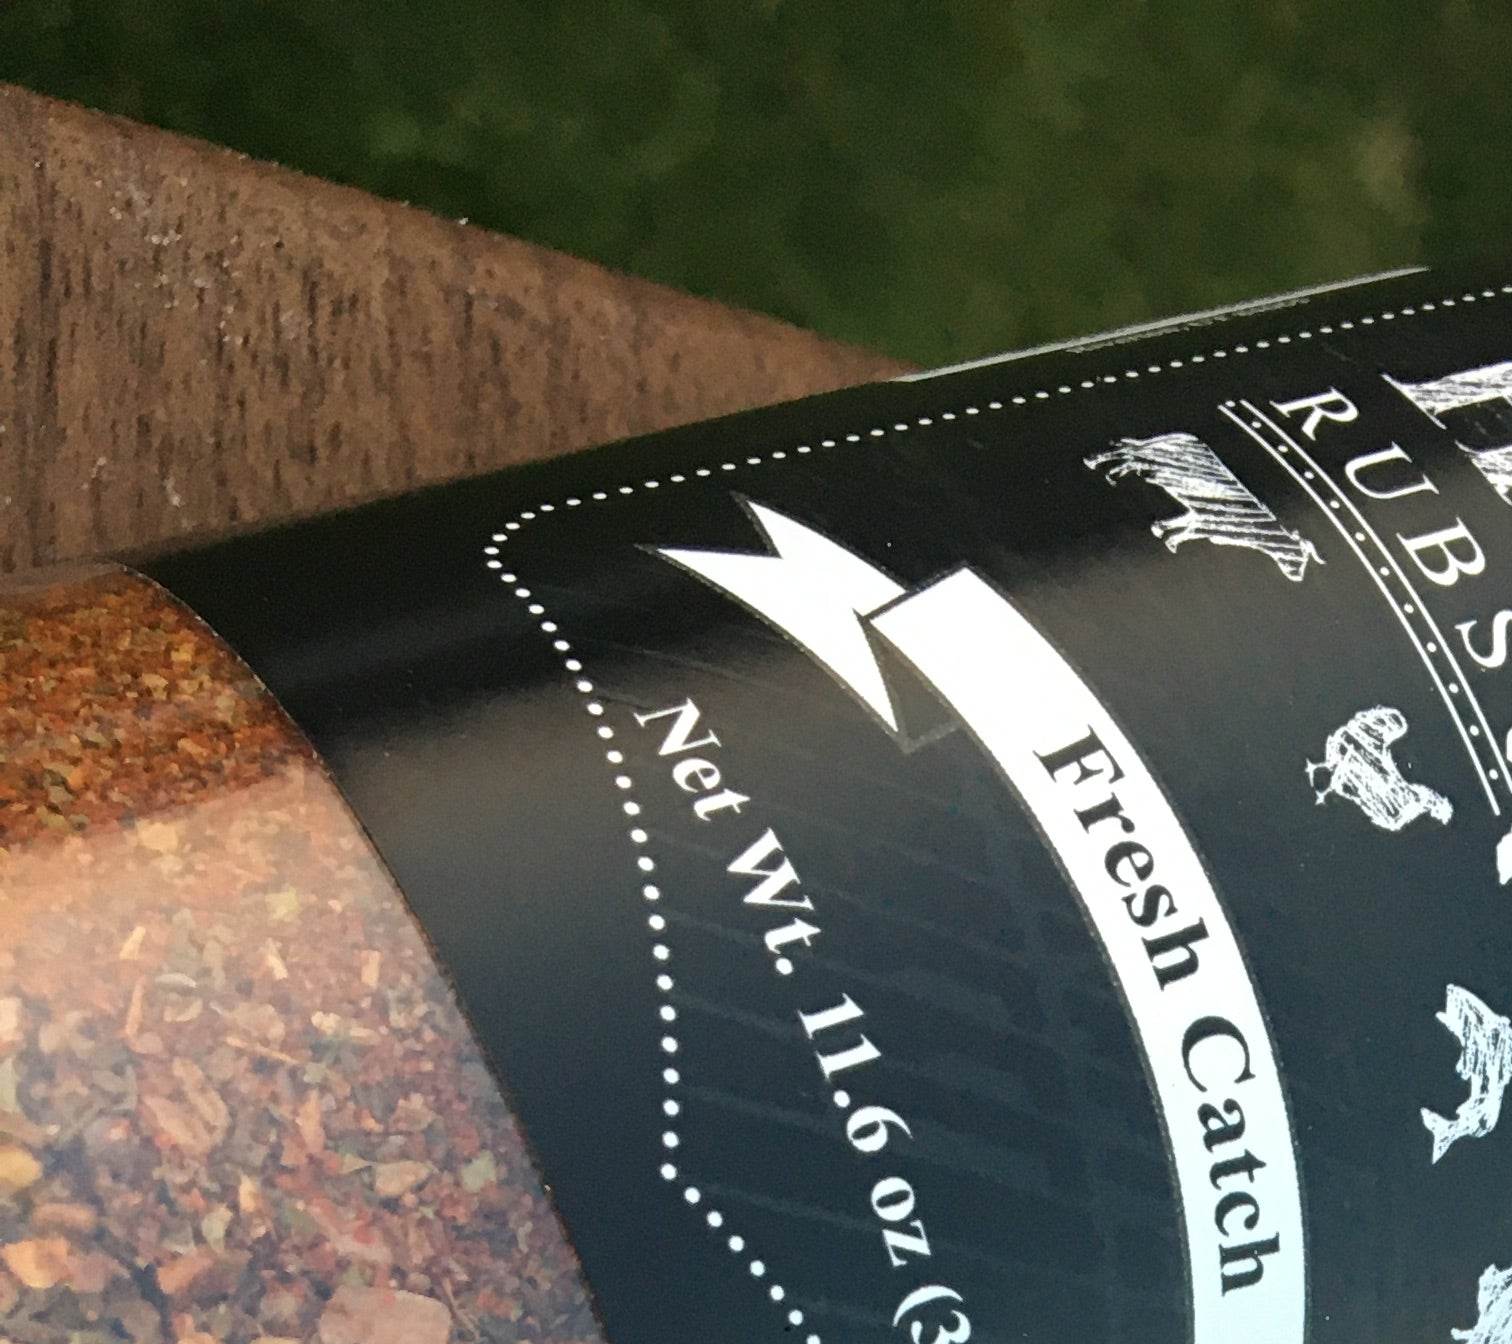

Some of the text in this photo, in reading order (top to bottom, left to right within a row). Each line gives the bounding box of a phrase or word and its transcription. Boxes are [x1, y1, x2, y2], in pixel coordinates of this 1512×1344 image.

[632, 696, 752, 823] Net
[726, 826, 822, 976] Wt.
[797, 992, 914, 1155] 11.6
[870, 1176, 932, 1268] oz
[1035, 725, 1282, 1298] Fresh Catch
